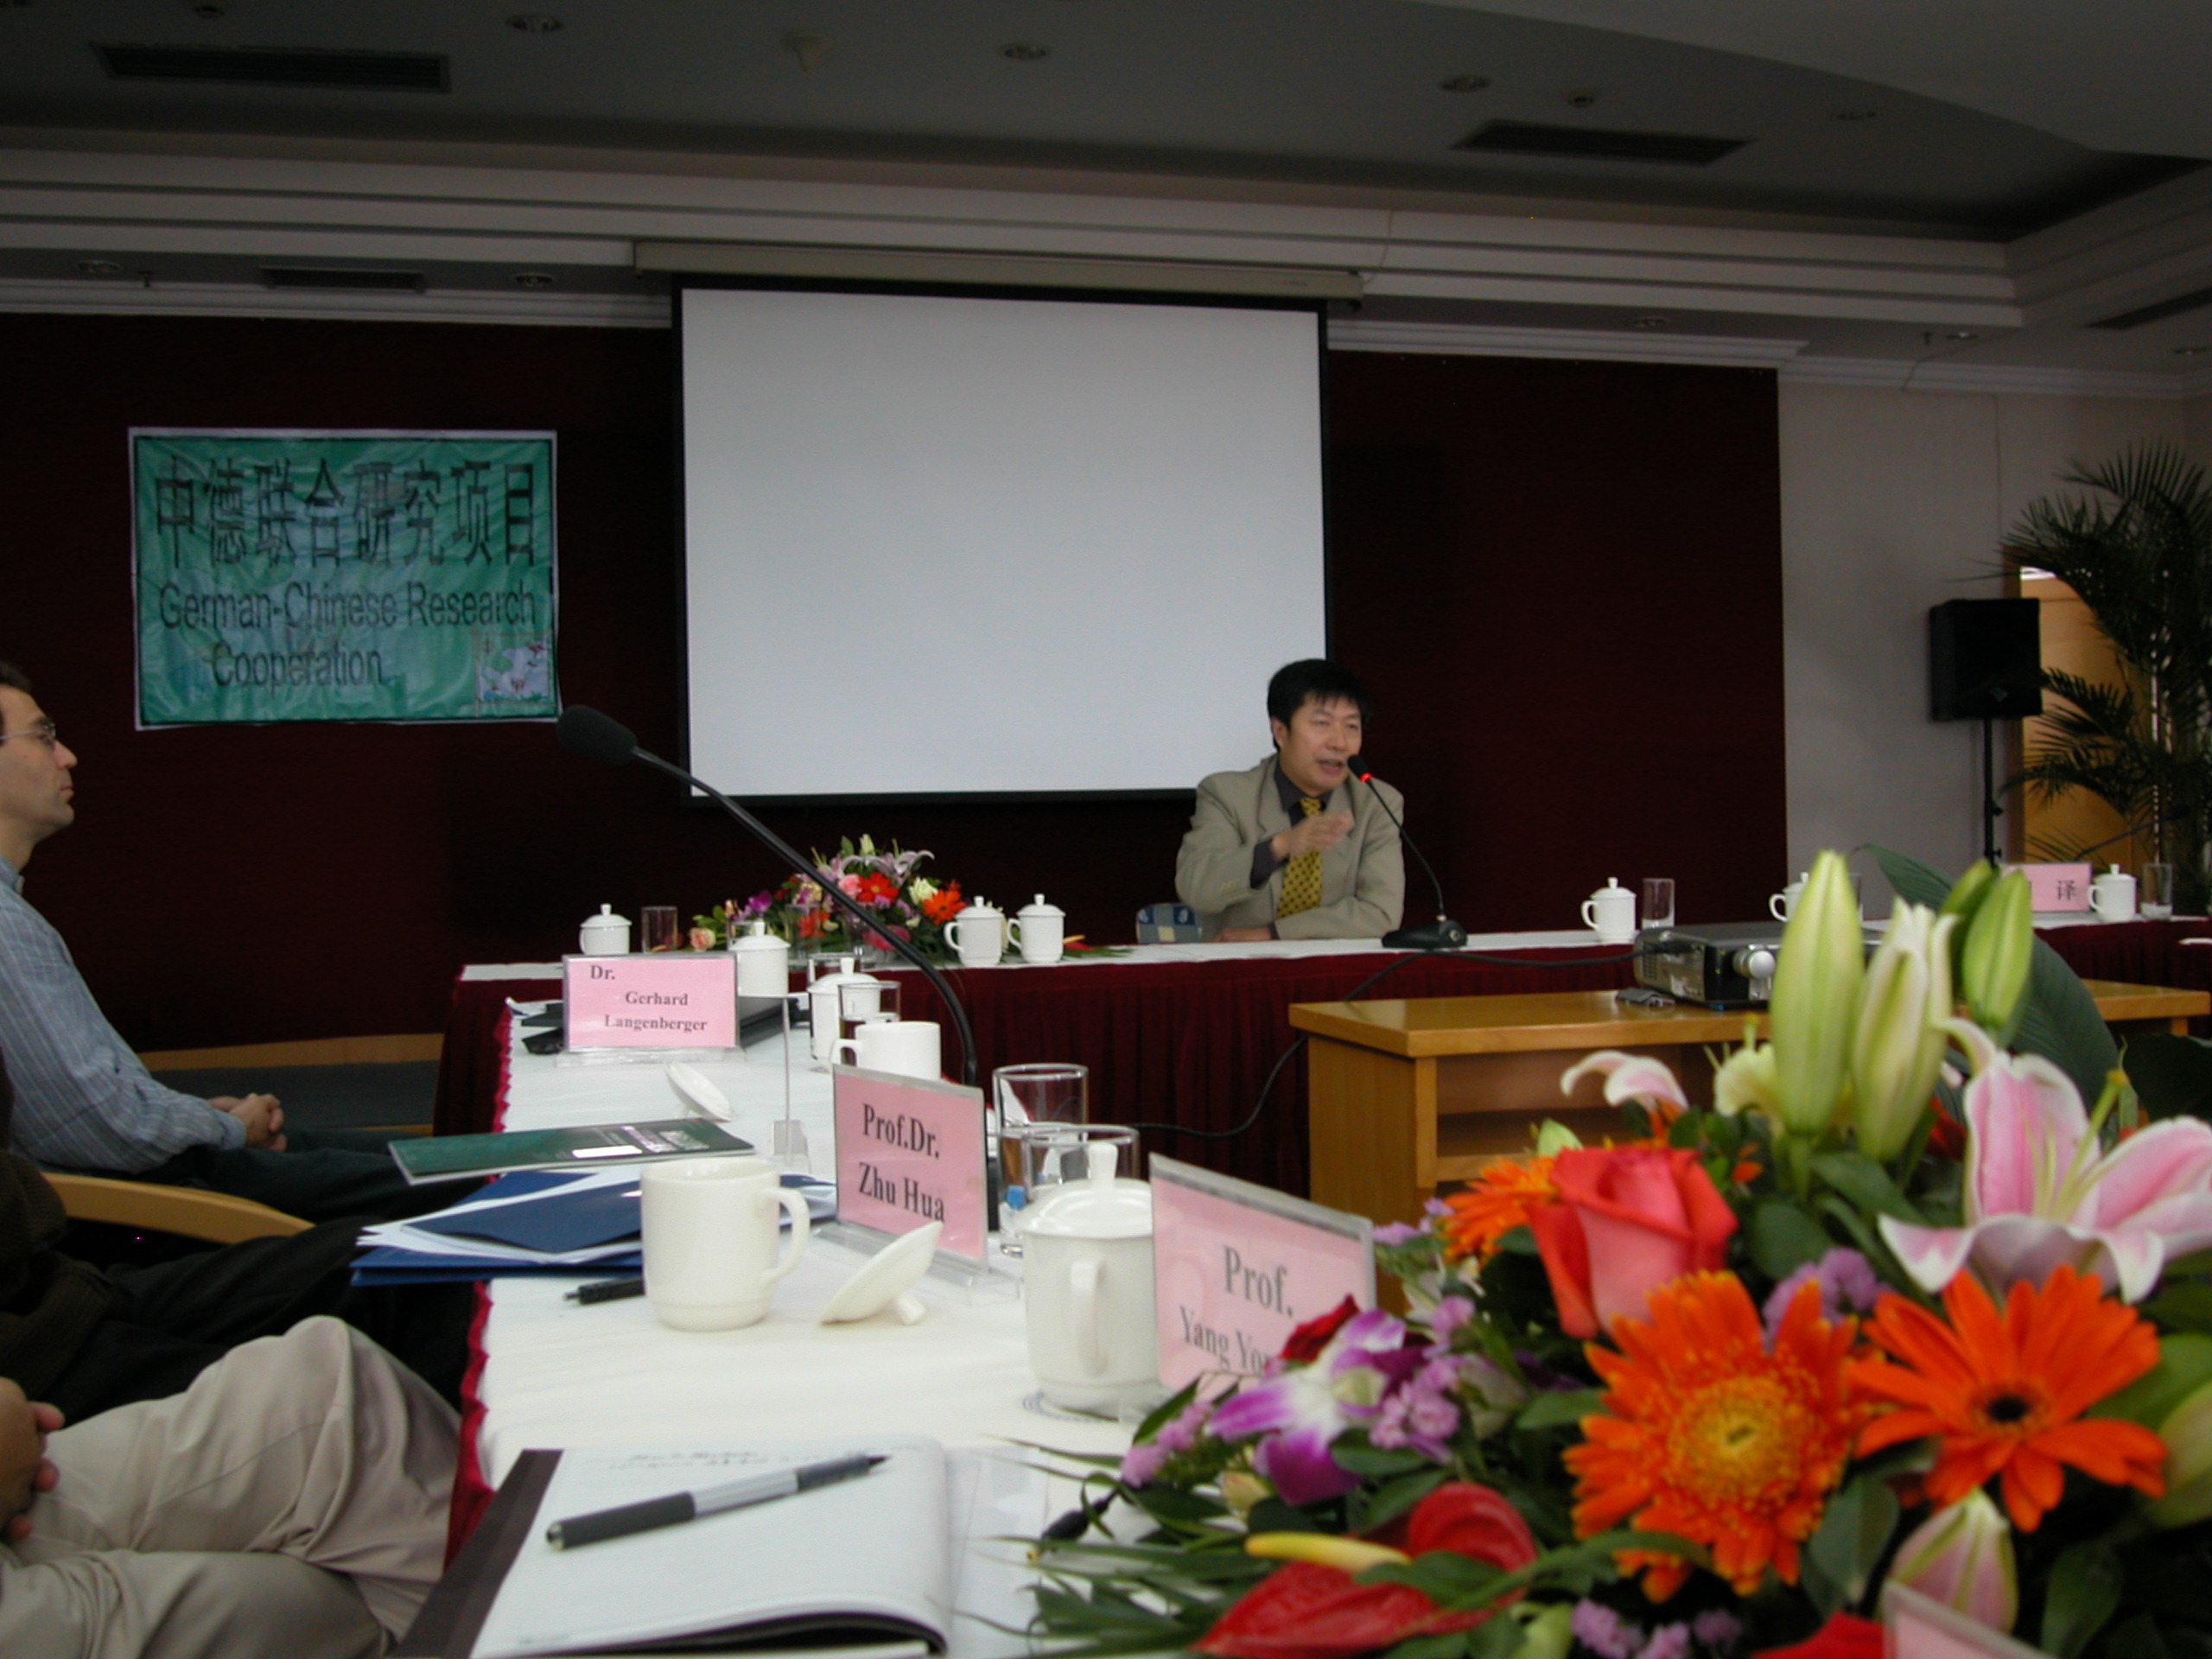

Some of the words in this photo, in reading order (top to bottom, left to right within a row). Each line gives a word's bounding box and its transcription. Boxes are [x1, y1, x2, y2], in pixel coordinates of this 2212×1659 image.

[156, 454, 535, 568] 中德联合研究项目
[159, 581, 398, 630] German-Chinese
[407, 580, 537, 628] Research
[212, 640, 385, 694] Cooperation
[590, 965, 615, 981] Dr.
[626, 991, 689, 1007] Gerhard
[605, 1014, 709, 1032] Langenberger
[863, 1103, 940, 1159] Prof.Dr.
[859, 1162, 895, 1205] Zhu
[904, 1177, 944, 1222] Hua
[1224, 1246, 1294, 1319] Prof.
[1179, 1305, 1230, 1371] Yang
